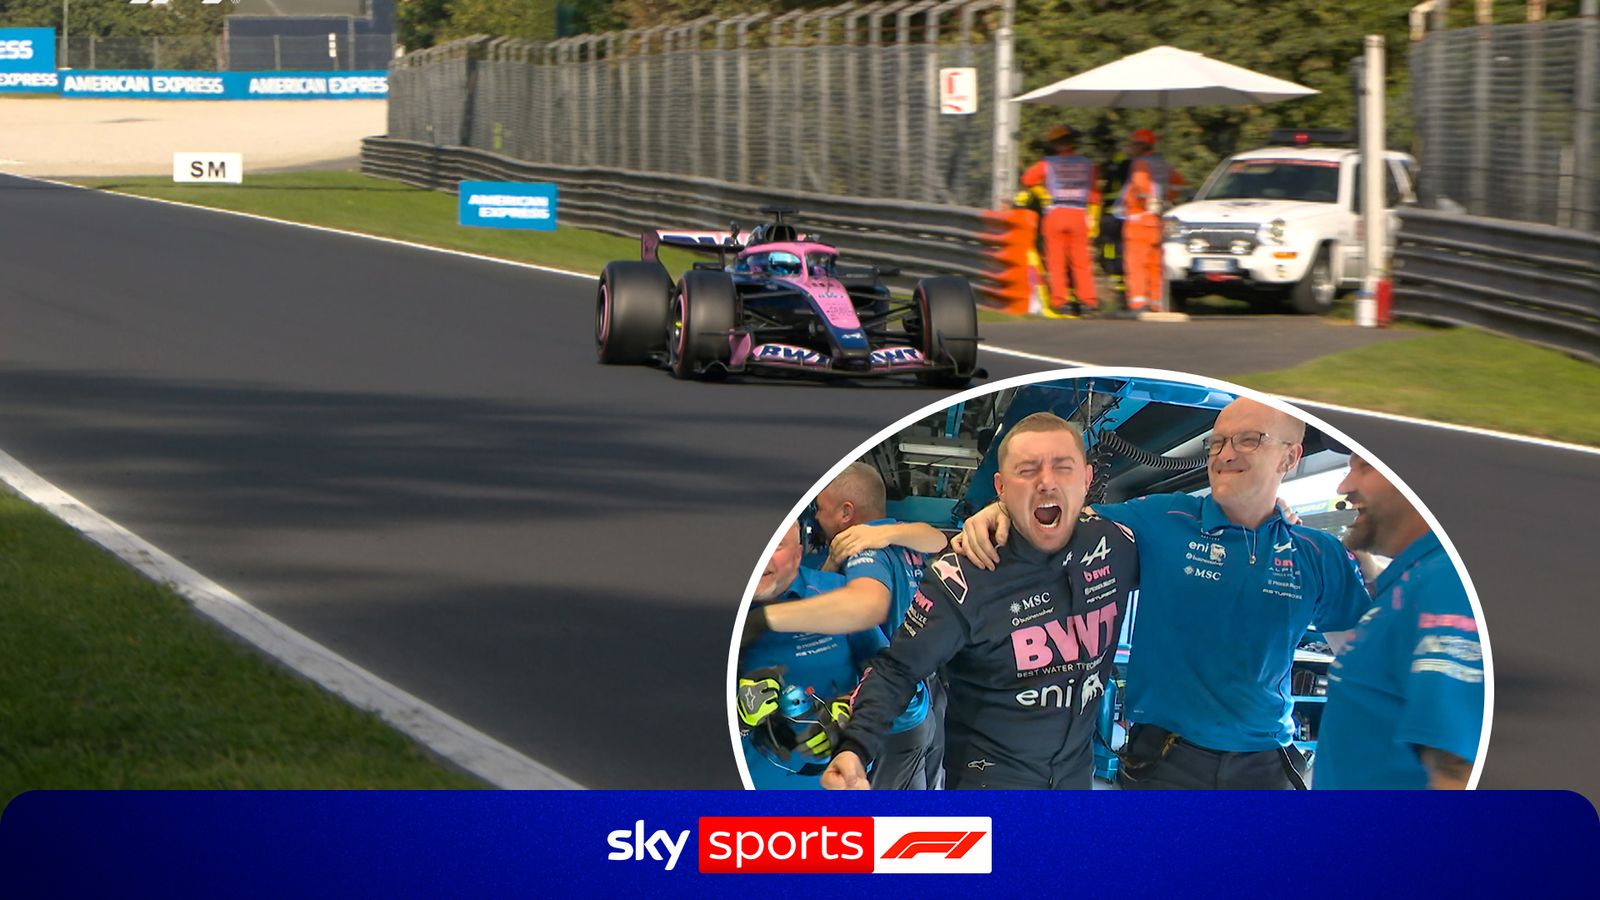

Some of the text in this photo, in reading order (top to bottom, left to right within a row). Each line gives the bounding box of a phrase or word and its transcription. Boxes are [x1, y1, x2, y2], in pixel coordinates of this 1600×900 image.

[63, 76, 225, 94] AMERICAN EXPRESS
[249, 77, 327, 94] AMERICAN
[190, 160, 226, 178] SM
[467, 194, 549, 207] AMERICAN
[478, 206, 551, 219] EXPRESS
[1188, 541, 1210, 553] eni
[1194, 568, 1222, 581] MSC
[1022, 592, 1052, 611] MSC
[1010, 601, 1118, 671] BWT
[1017, 664, 1074, 679] BEST WATER
[1015, 678, 1075, 708] eni
